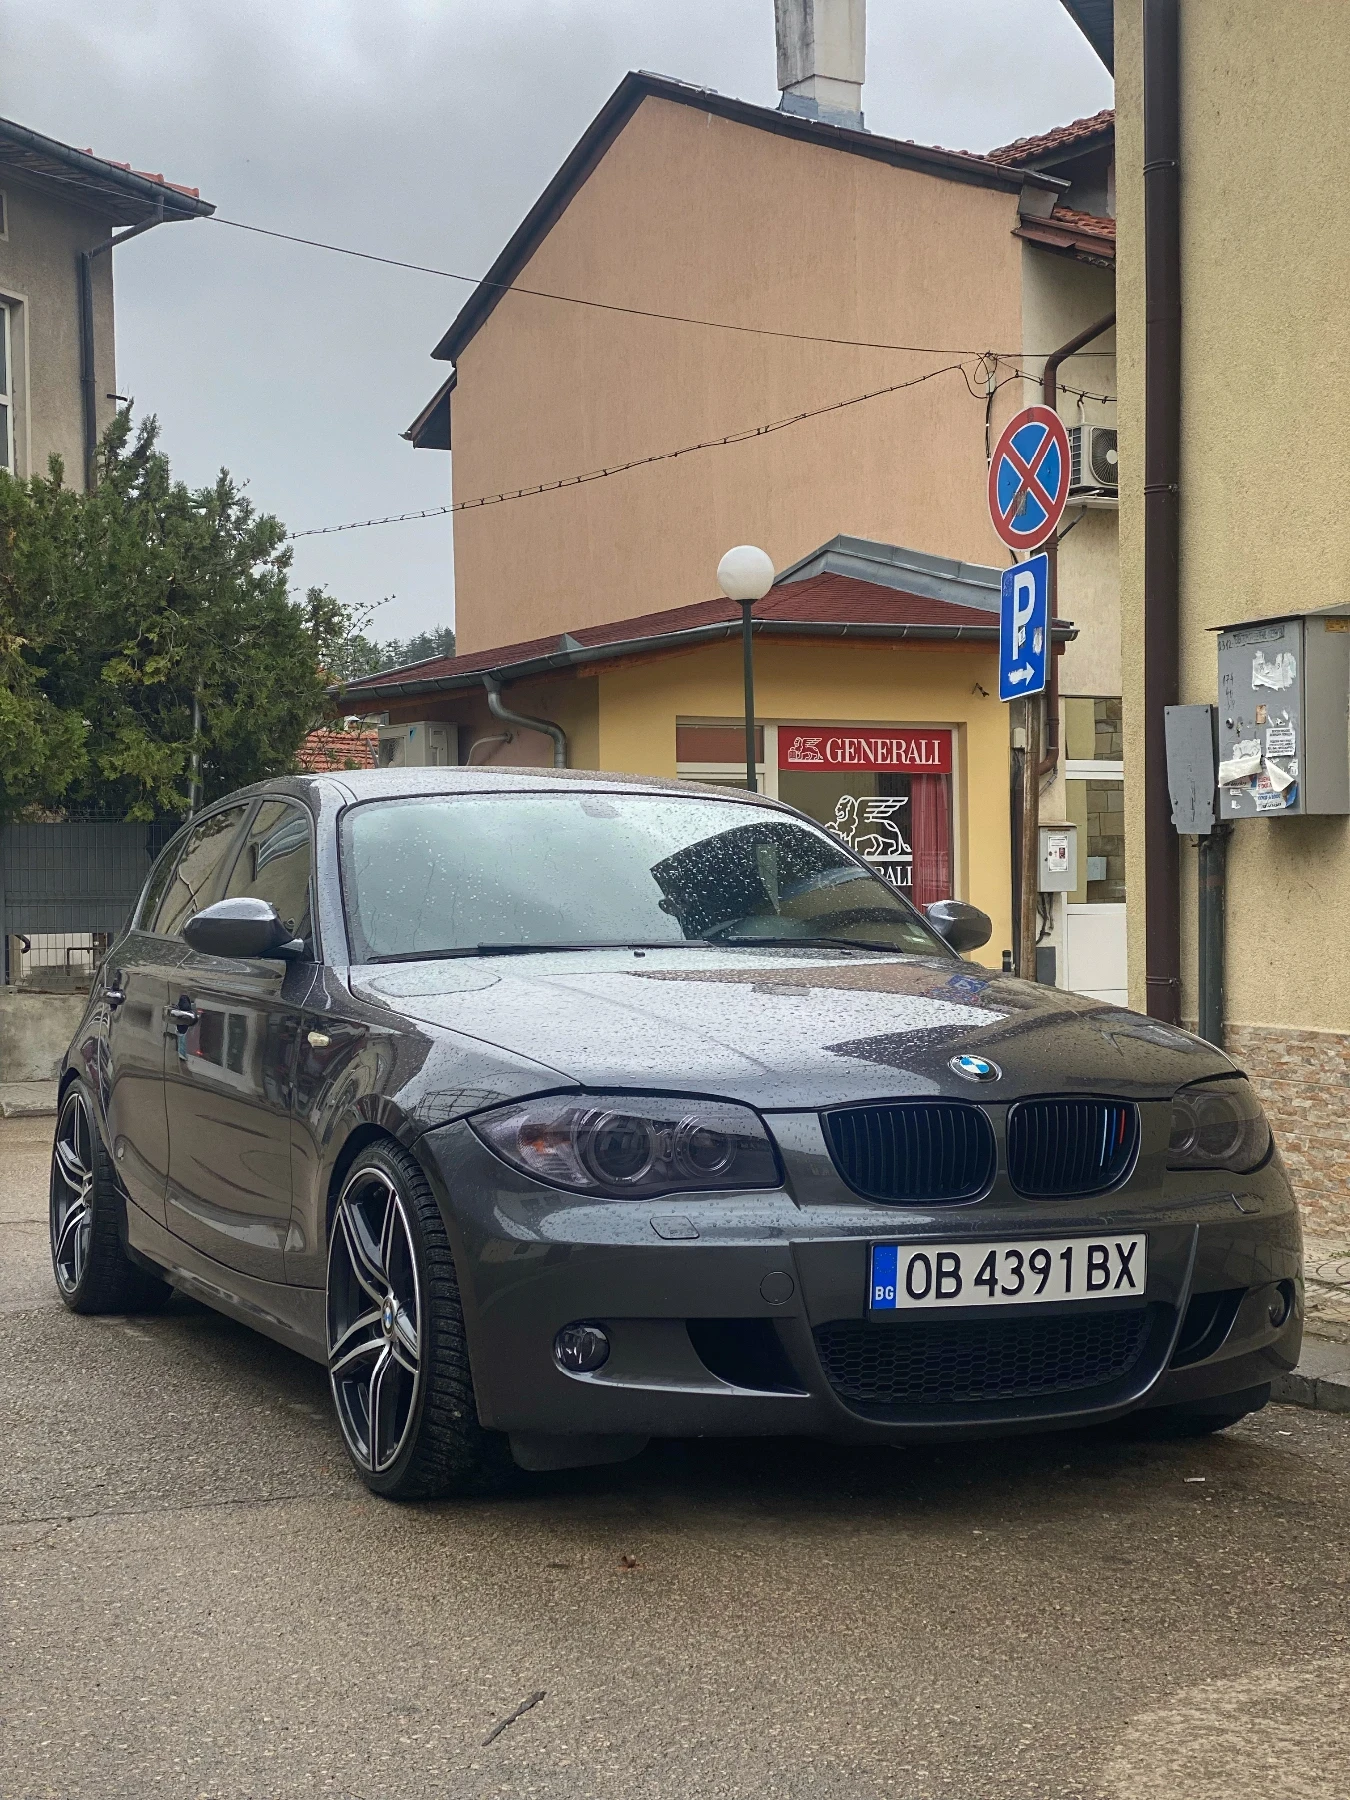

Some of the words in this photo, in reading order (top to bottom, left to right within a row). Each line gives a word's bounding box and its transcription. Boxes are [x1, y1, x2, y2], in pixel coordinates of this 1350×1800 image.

[1012, 570, 1036, 661] P
[826, 737, 941, 765] GENERALI
[905, 1252, 963, 1300] OB
[974, 1246, 1073, 1297] 4391
[1086, 1241, 1138, 1292] BX
[875, 1285, 895, 1301] BG
